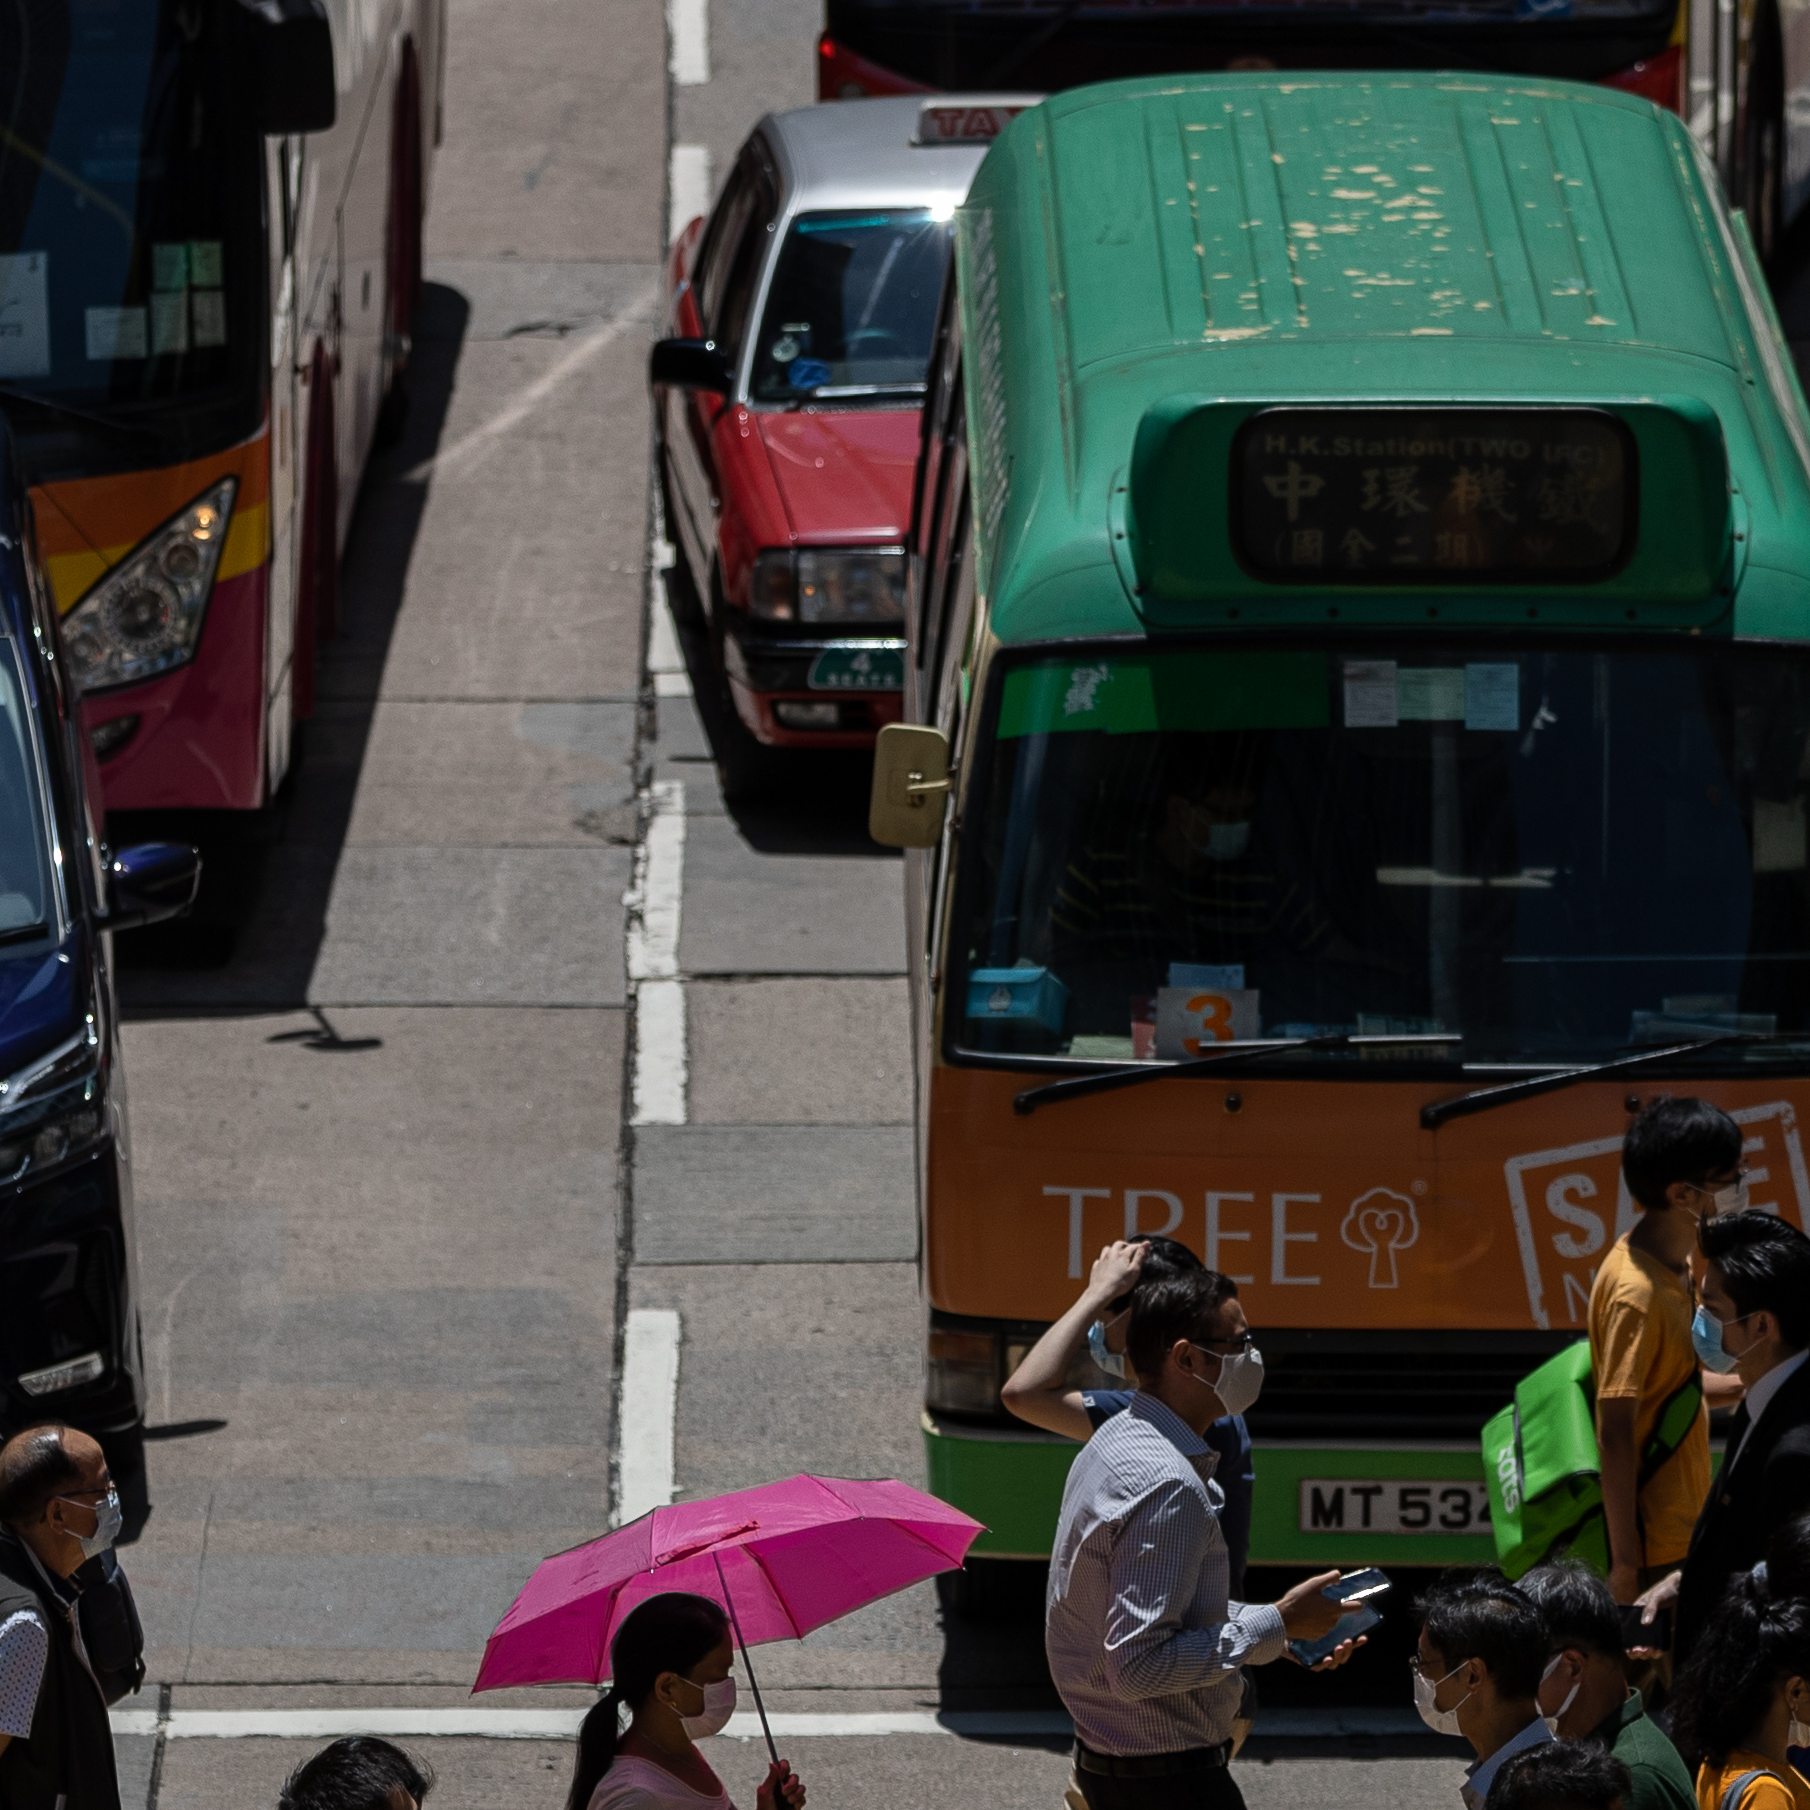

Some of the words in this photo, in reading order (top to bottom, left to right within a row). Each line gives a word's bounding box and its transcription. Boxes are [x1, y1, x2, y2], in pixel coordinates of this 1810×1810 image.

[931, 108, 1022, 137] TA
[850, 652, 871, 674] 4
[1184, 995, 1234, 1058] 3
[1042, 1184, 1322, 1286] TREE
[1312, 1486, 1382, 1527] MT
